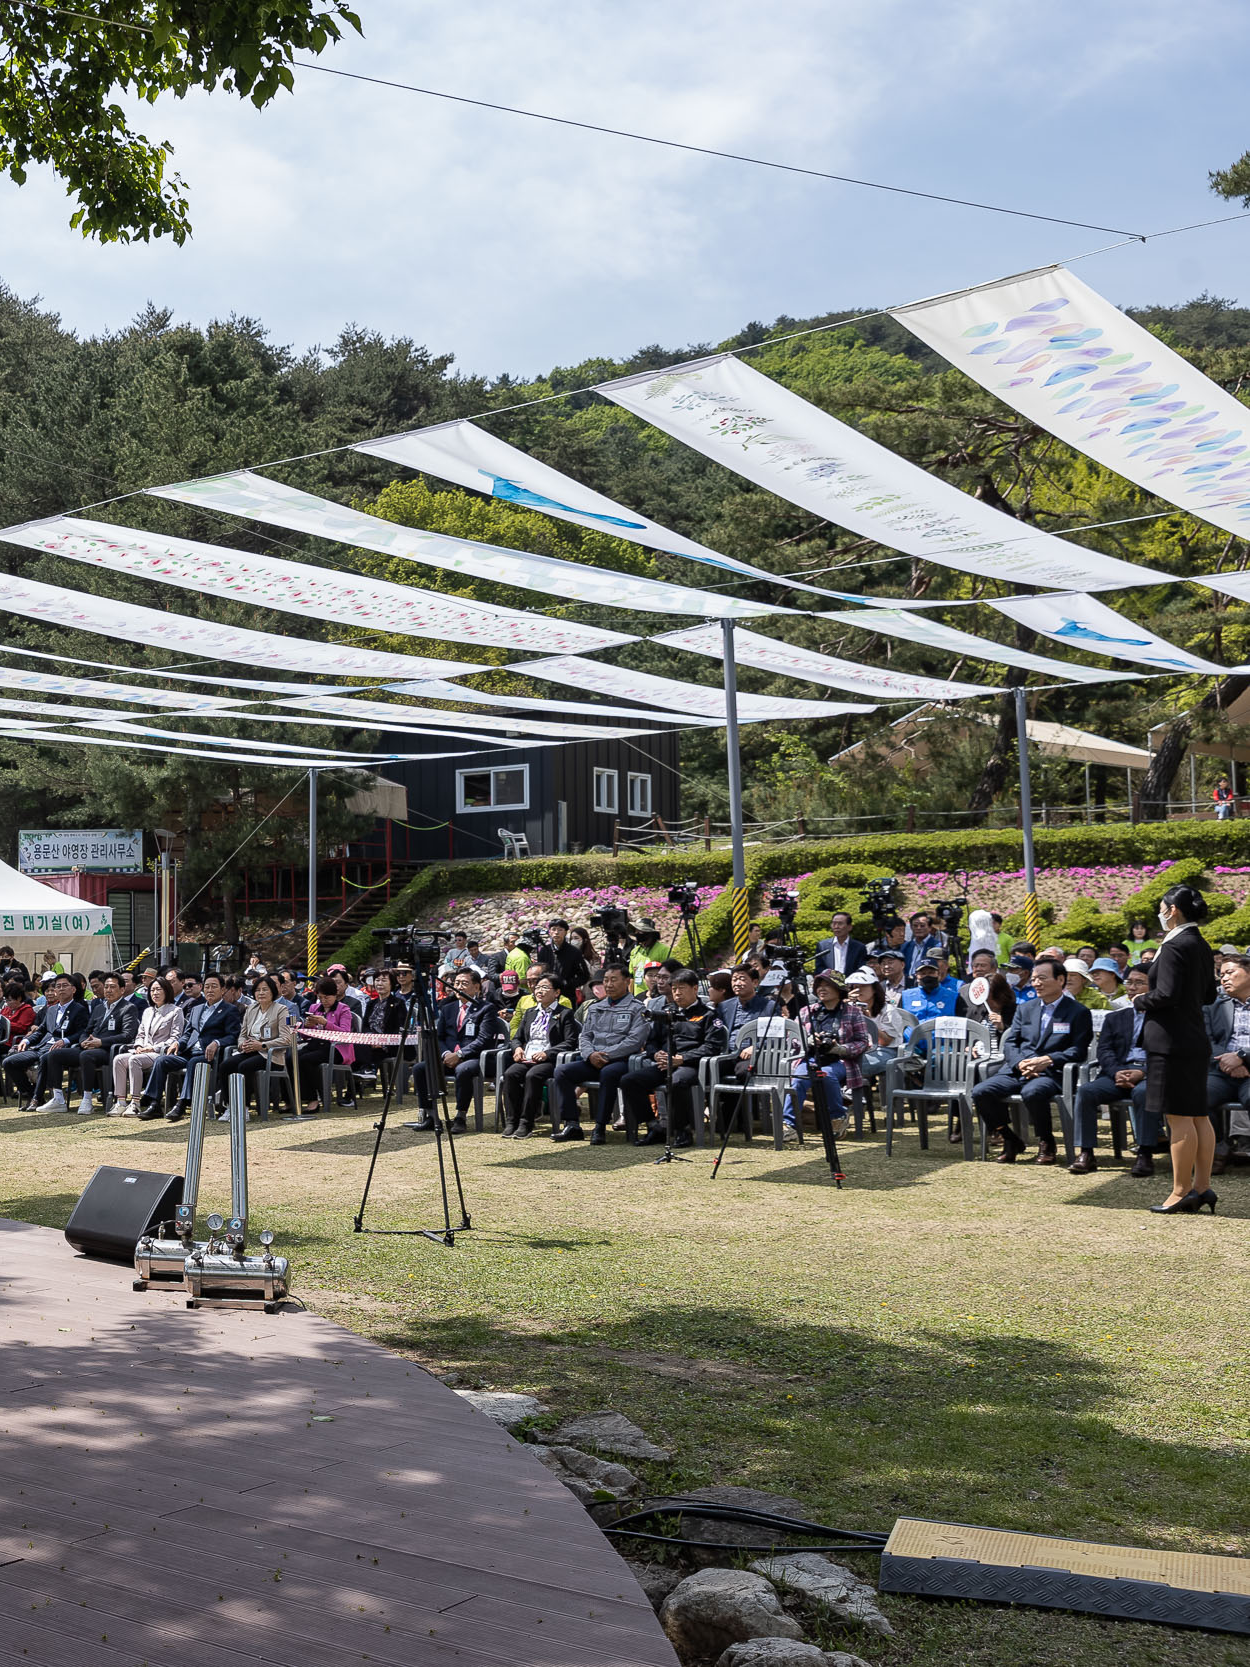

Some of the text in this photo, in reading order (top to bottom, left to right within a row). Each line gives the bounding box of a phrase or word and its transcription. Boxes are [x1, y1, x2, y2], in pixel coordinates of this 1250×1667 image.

[33, 843, 135, 860] 용문산 야영장 관리사무소
[23, 914, 91, 932] 대기실(여)
